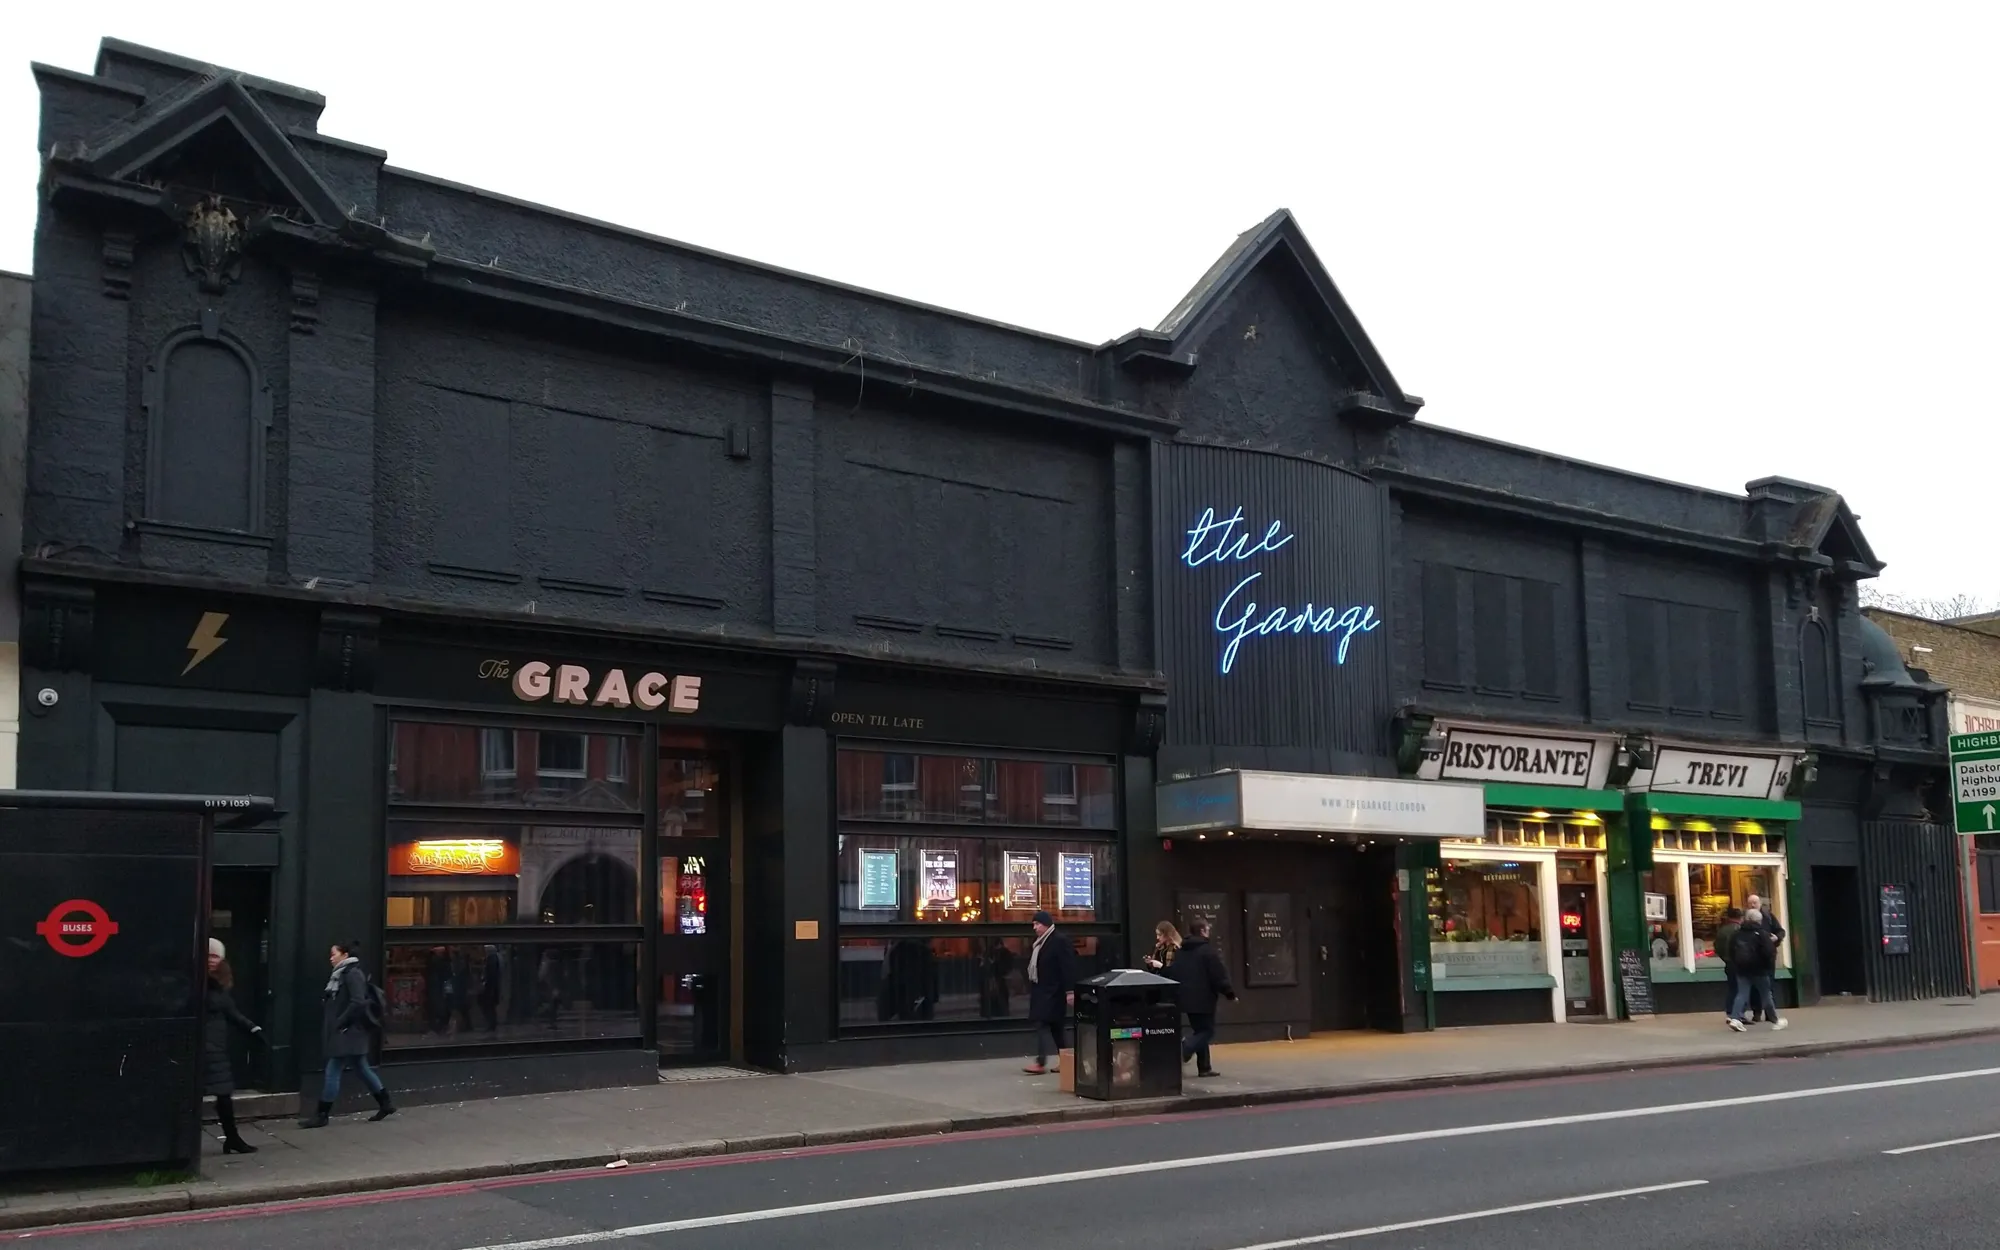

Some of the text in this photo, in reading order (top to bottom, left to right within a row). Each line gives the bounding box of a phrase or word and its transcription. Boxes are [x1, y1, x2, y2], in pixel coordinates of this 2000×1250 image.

[1181, 505, 1295, 567] the
[1215, 571, 1381, 674] Garage
[477, 659, 702, 714] The GRACE
[831, 712, 925, 729] OPEN TIL LATE
[1957, 735, 2000, 748] HIGHB
[1446, 740, 1589, 776] RISTORANTE
[1687, 760, 1749, 788] TREVI
[1775, 770, 1790, 787] 16
[1483, 873, 1520, 881] RESTAURANT
[62, 924, 92, 932] BUSES
